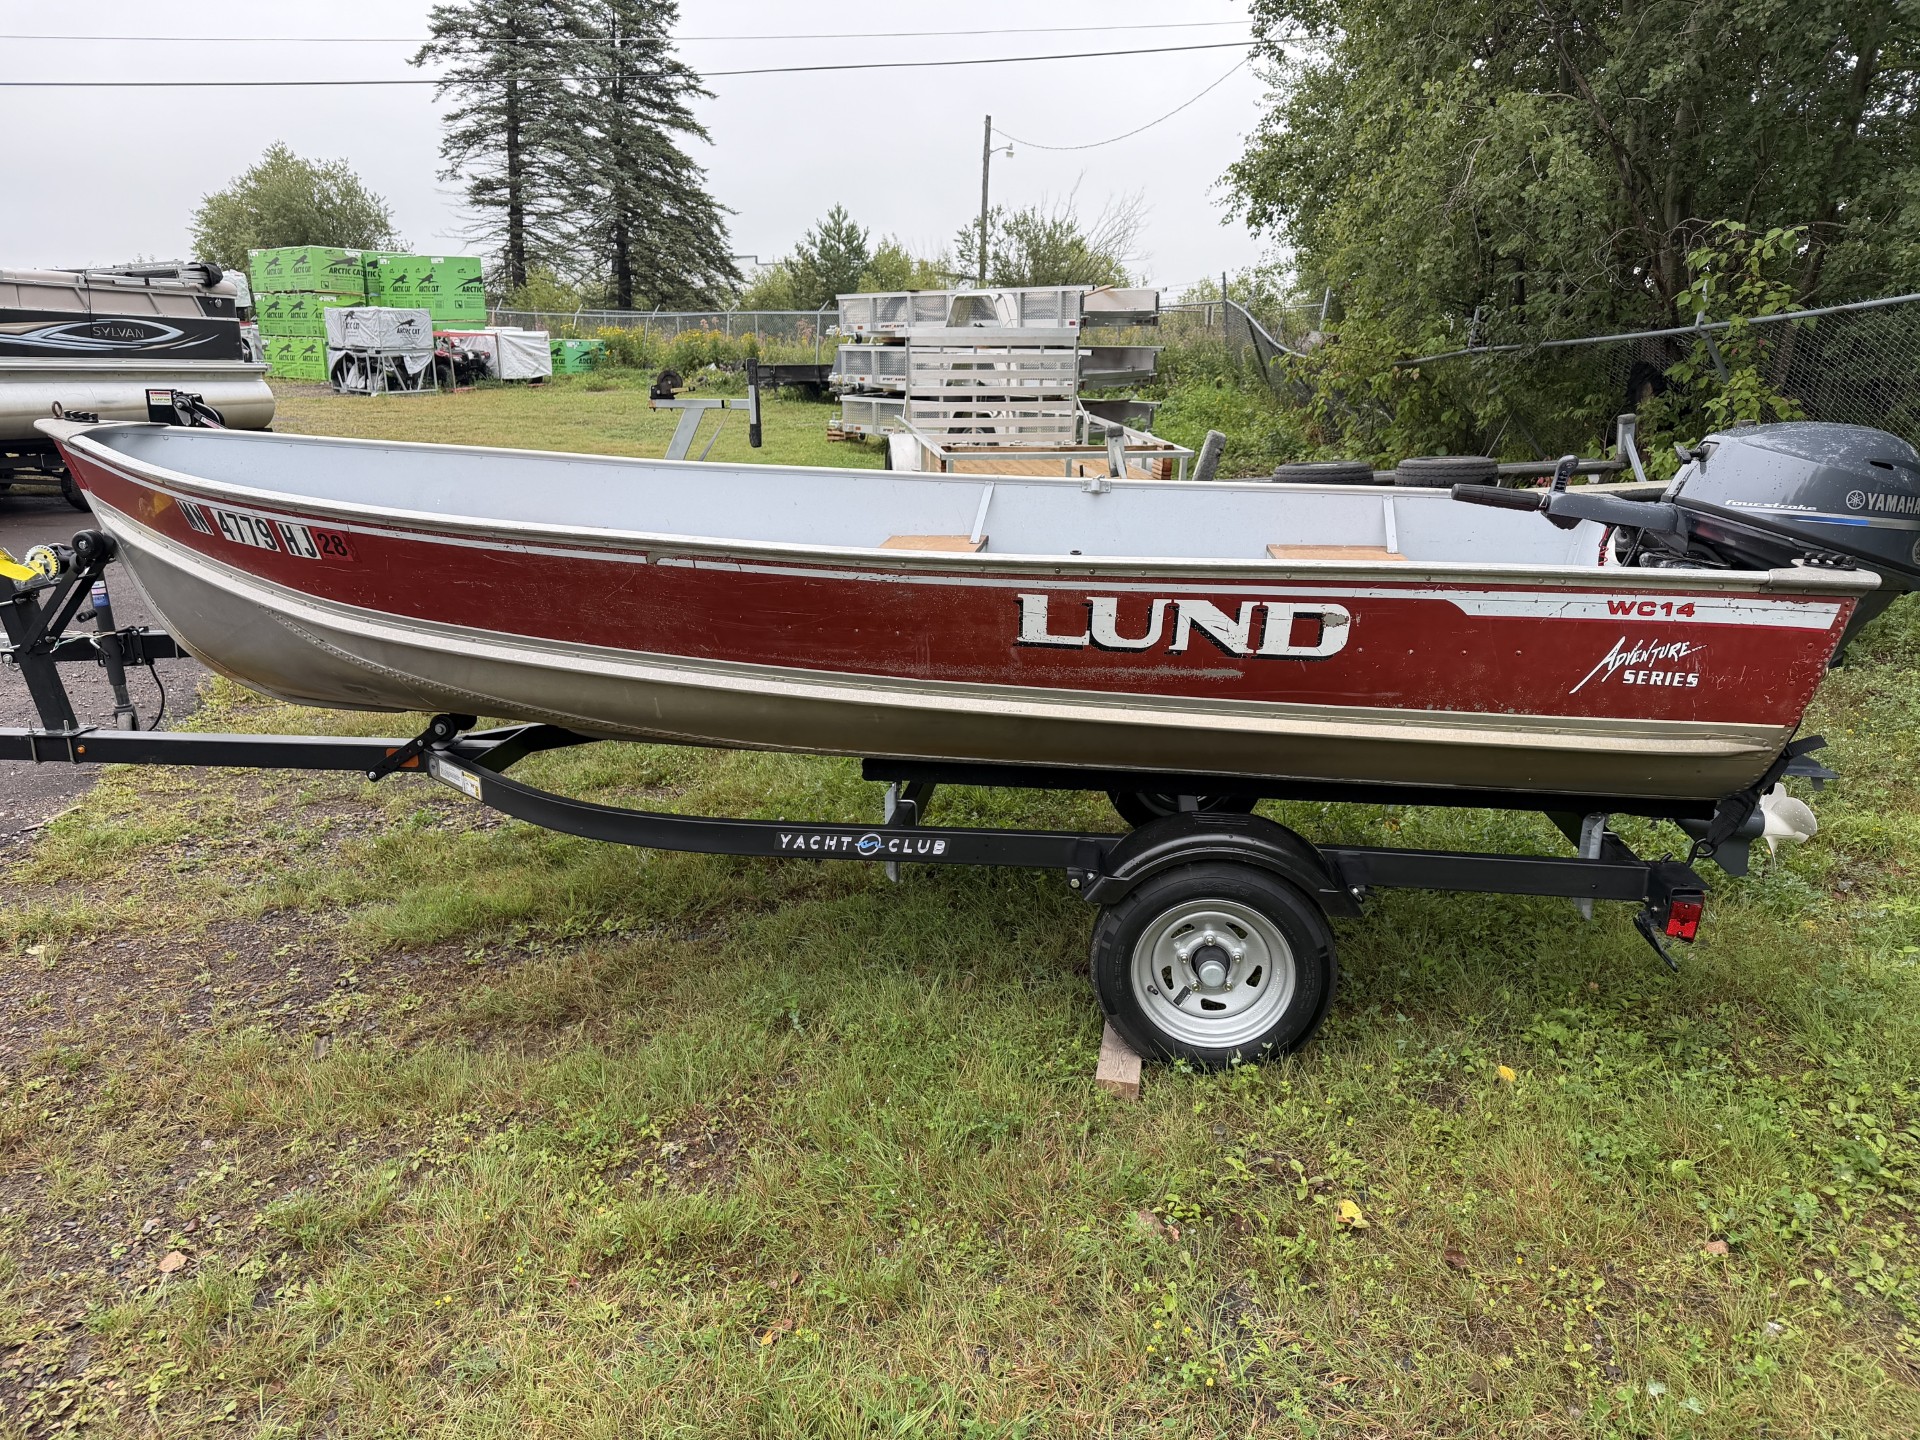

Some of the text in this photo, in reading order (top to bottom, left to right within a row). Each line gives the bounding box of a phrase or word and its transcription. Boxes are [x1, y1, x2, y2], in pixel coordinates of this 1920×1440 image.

[329, 267, 351, 275] ARCTIC
[92, 326, 145, 338] SYLVAN
[176, 502, 318, 558] MN 4779 HJ
[317, 533, 347, 556] 28
[1607, 600, 1696, 617] WC14
[1013, 594, 1350, 661] LUND
[1622, 670, 1700, 688] SERIES
[780, 834, 946, 855] YACHT CLUB
